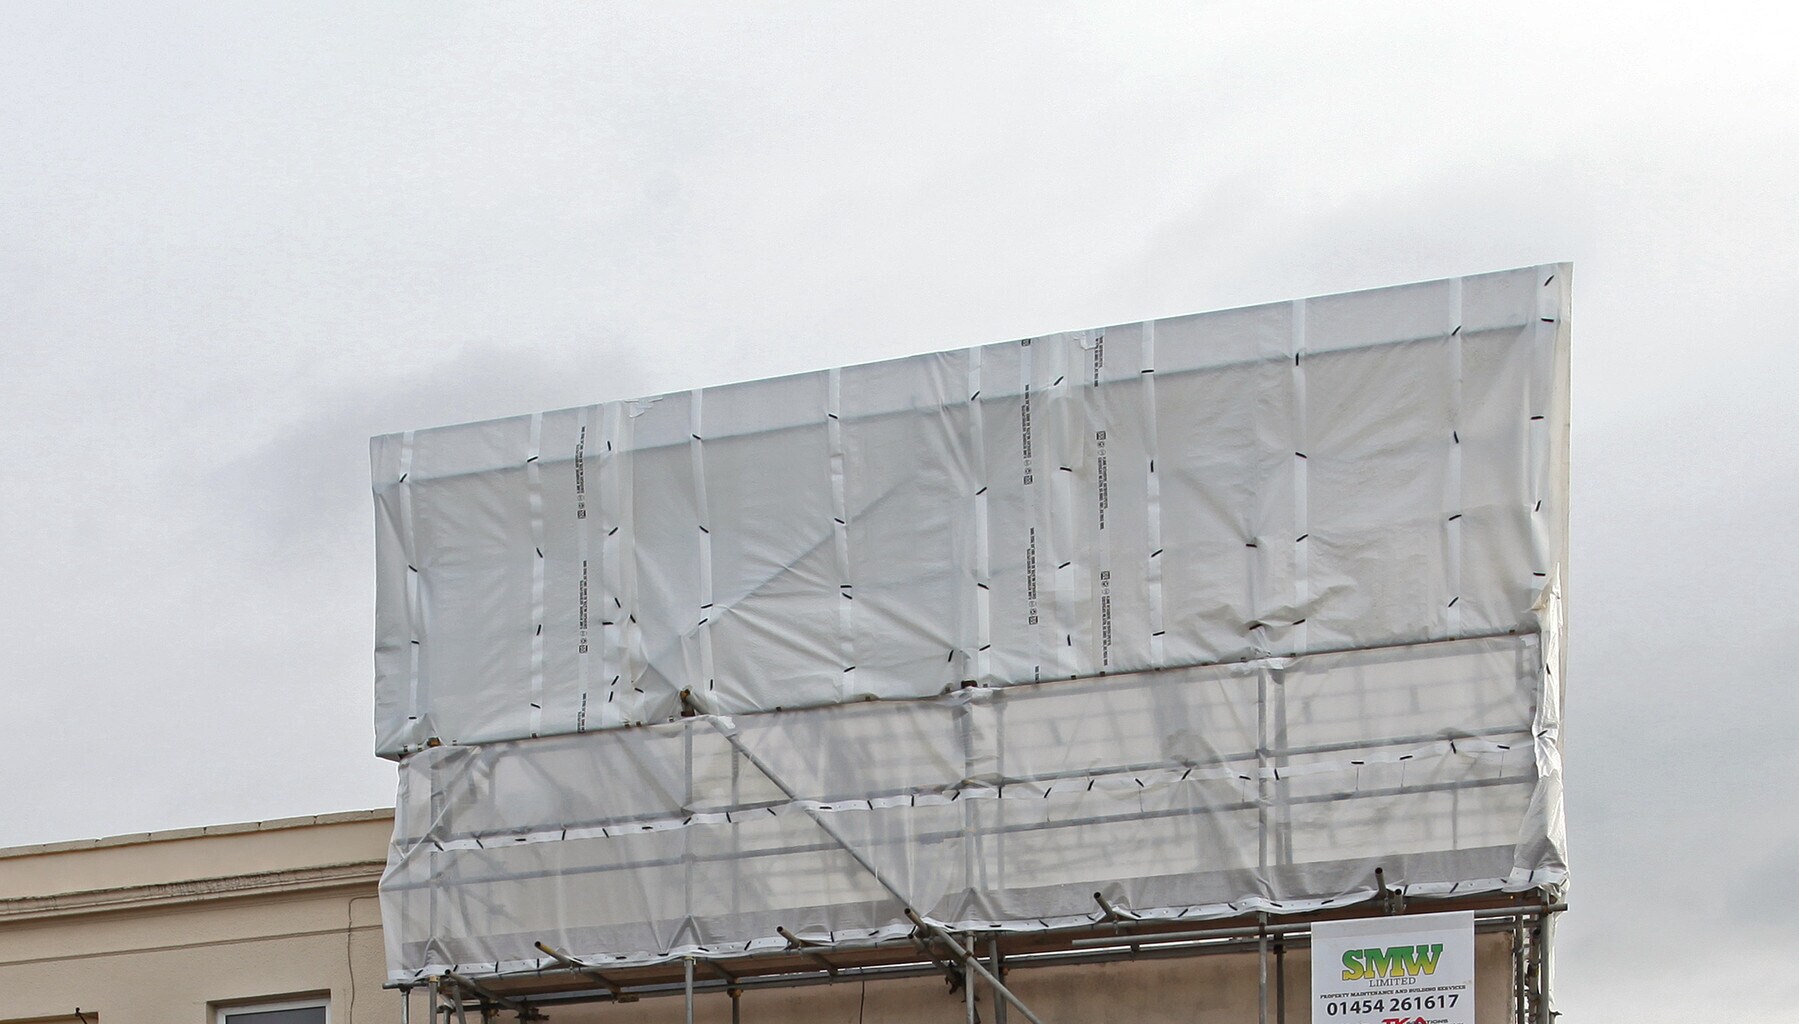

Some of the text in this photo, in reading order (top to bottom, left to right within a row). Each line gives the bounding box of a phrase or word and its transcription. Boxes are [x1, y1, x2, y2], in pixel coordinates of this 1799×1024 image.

[1342, 943, 1444, 981] SMW
[1369, 977, 1416, 988] LIMITED
[1350, 989, 1394, 998] MAINTENANCE
[1327, 994, 1459, 1016] 01454 261617
